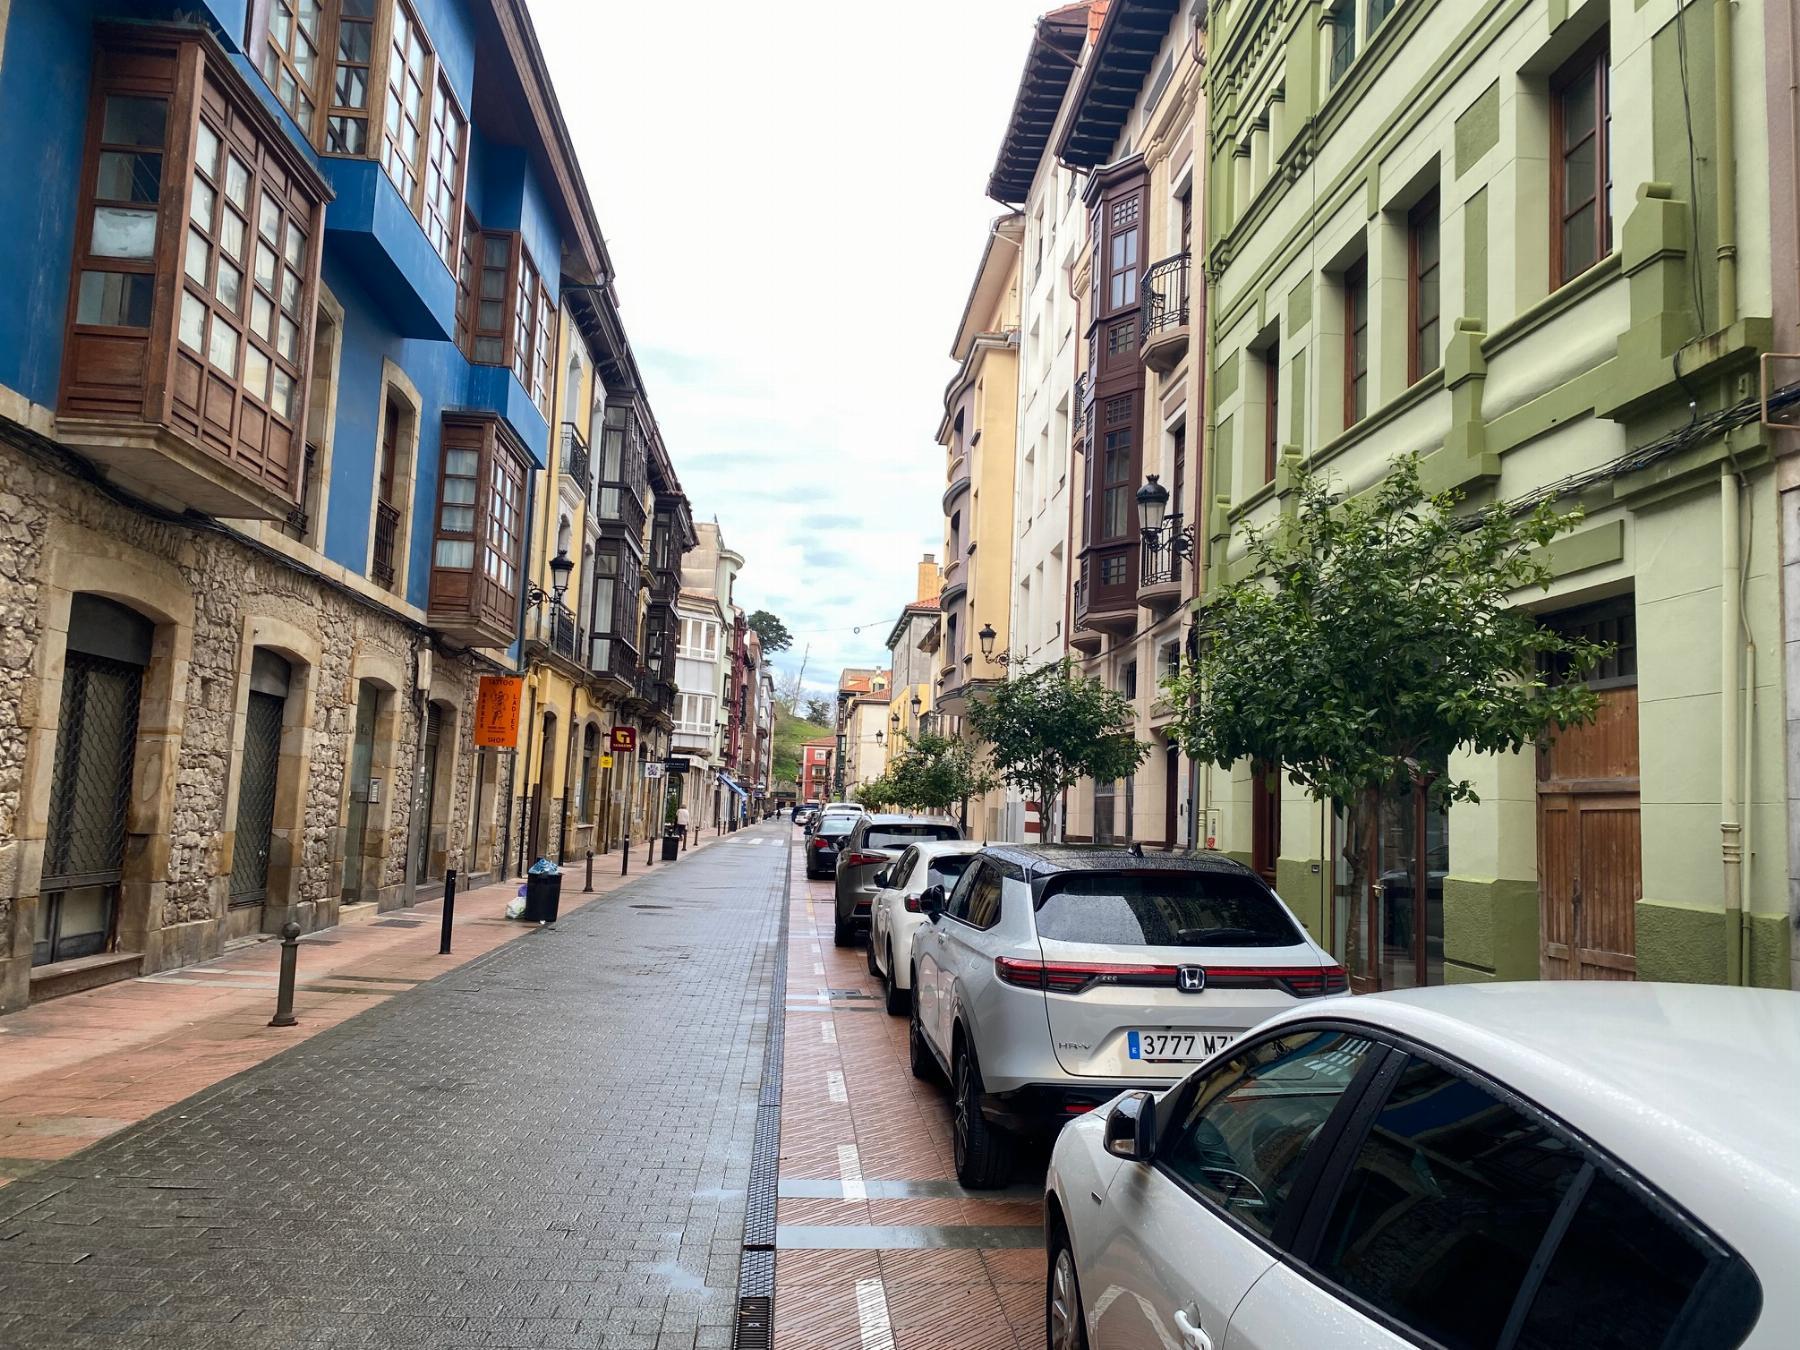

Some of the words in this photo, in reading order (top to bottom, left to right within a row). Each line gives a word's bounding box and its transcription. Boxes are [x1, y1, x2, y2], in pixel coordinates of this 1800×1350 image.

[489, 679, 514, 687] TATTOO
[510, 694, 518, 731] LADIES
[1058, 1041, 1091, 1050] HR-V
[1143, 1035, 1196, 1056] 3777
